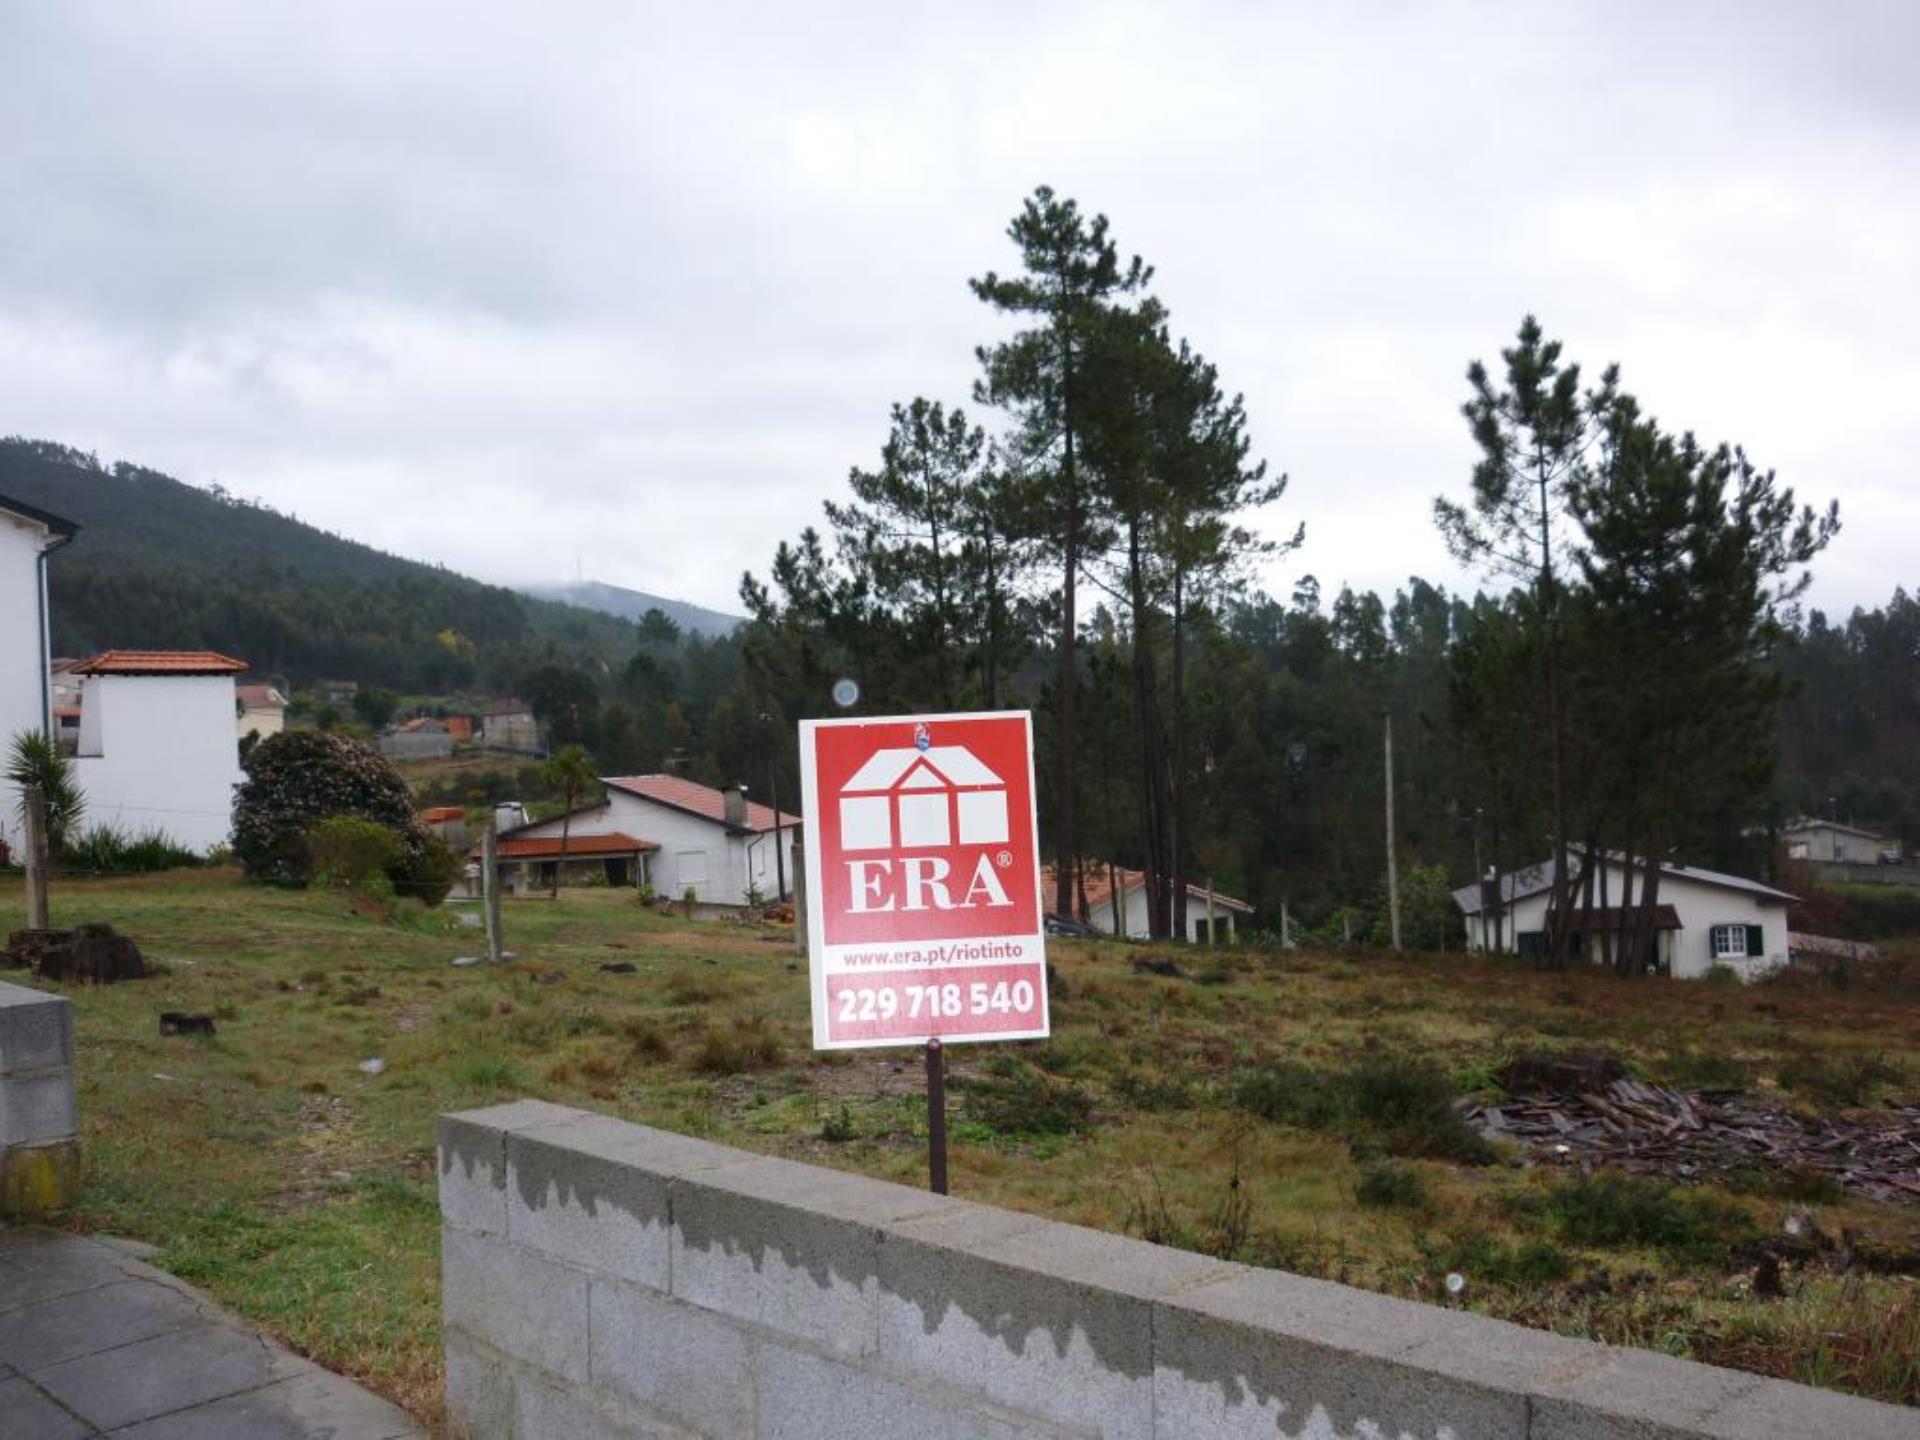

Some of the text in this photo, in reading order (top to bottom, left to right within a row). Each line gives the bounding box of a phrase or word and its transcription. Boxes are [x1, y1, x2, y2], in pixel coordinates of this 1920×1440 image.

[844, 941, 1023, 966] www.era.pt/riotinto
[838, 980, 1034, 1022] 229 718 540
